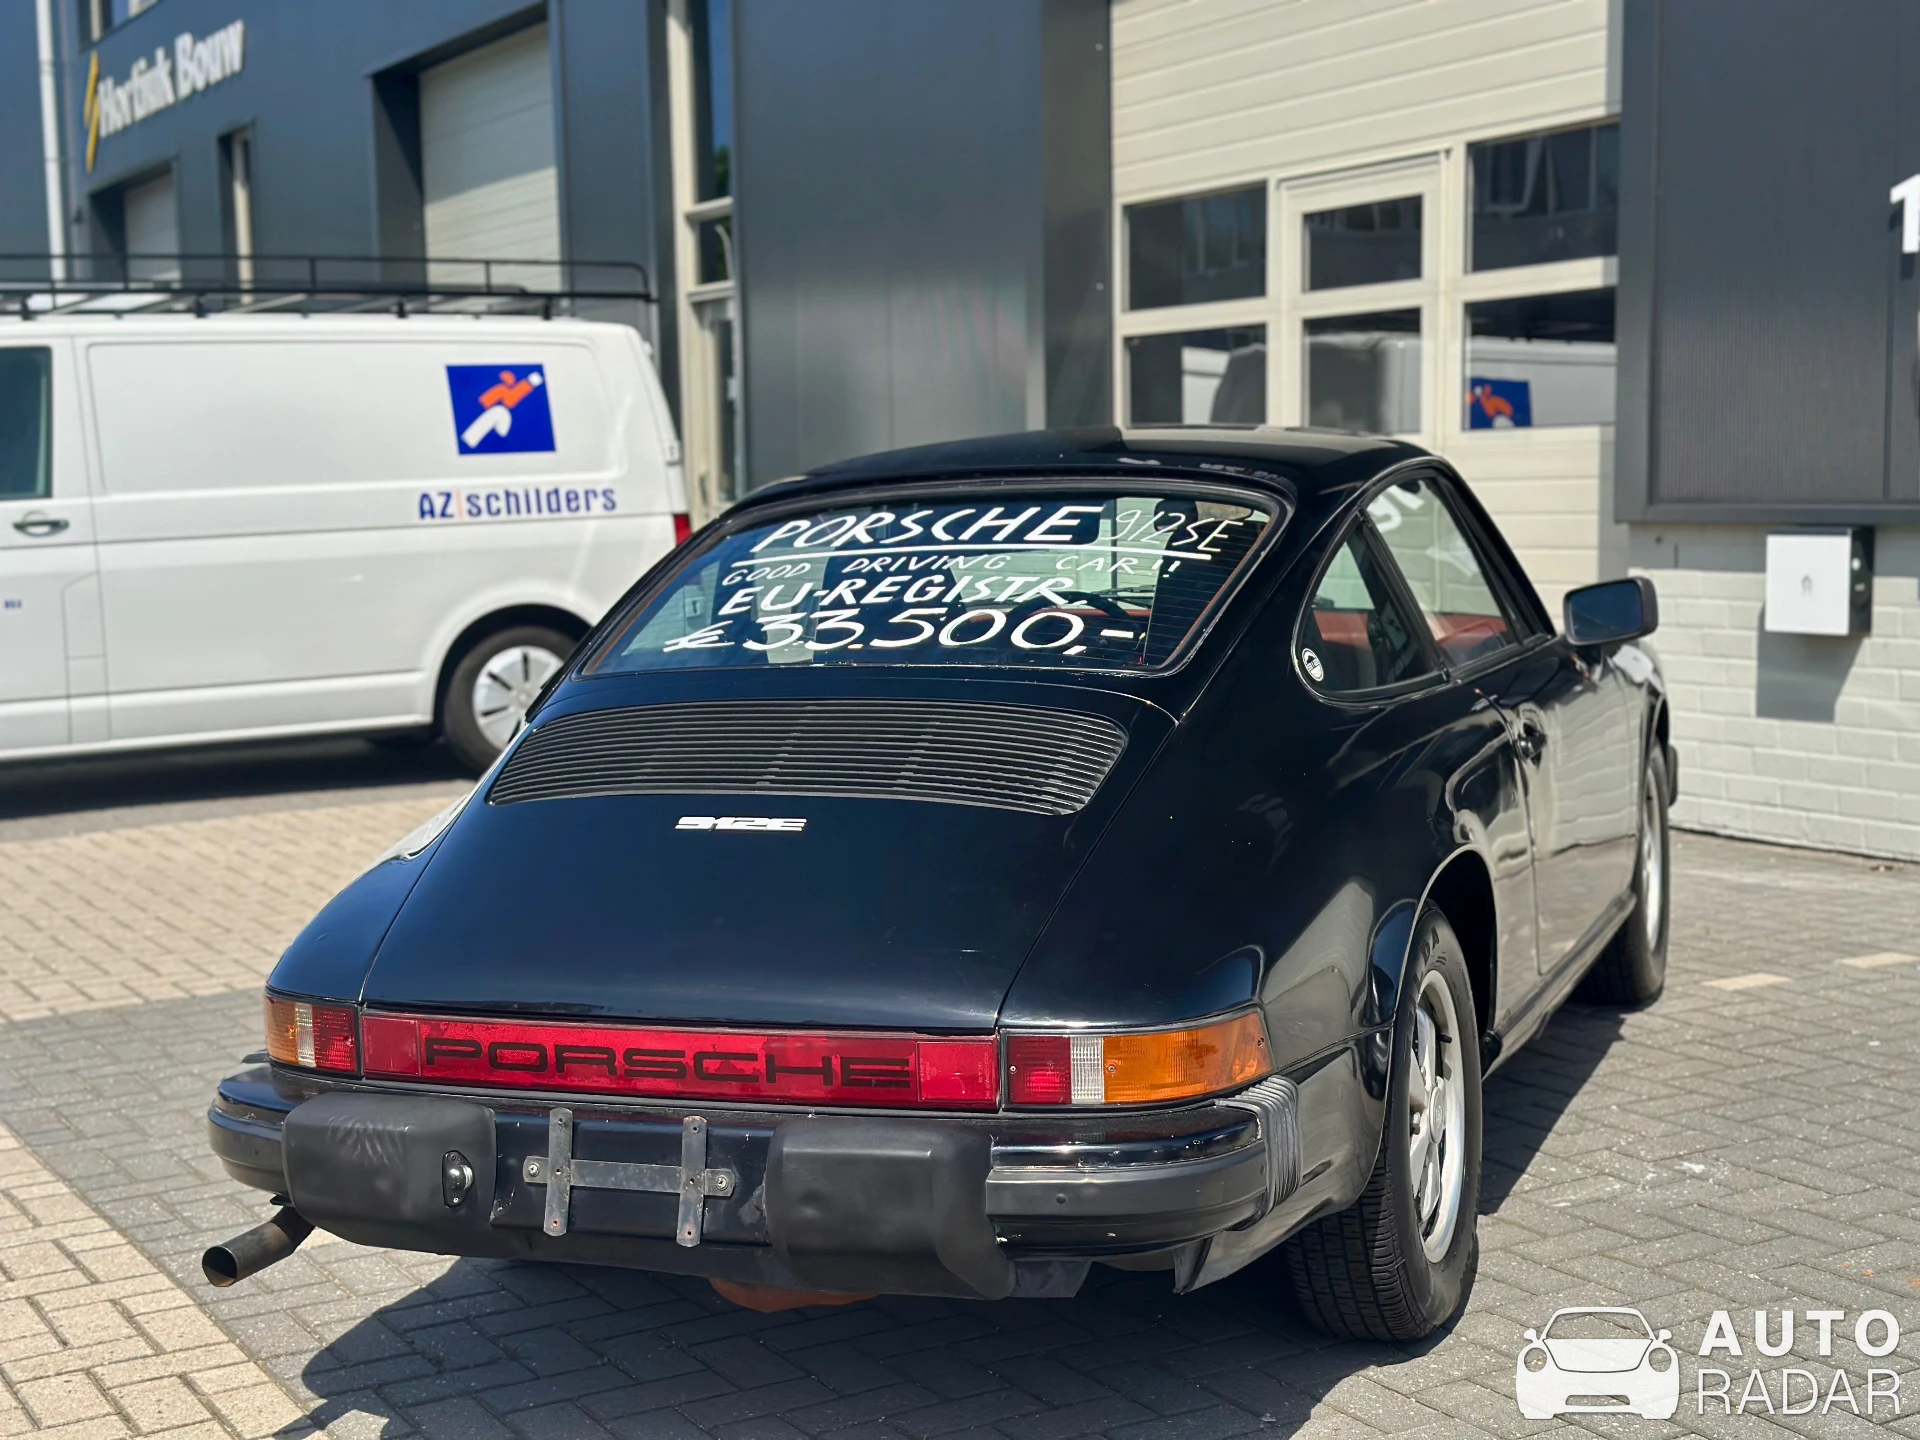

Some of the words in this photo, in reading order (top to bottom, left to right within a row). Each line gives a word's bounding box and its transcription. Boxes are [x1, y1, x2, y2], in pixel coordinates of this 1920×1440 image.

[174, 19, 244, 100] Bouw
[466, 488, 617, 517] schilders
[750, 505, 1105, 552] PORSCHE
[721, 562, 811, 586] GOOD
[841, 552, 1012, 574] DRIVING
[425, 1036, 911, 1089] PORSCHE
